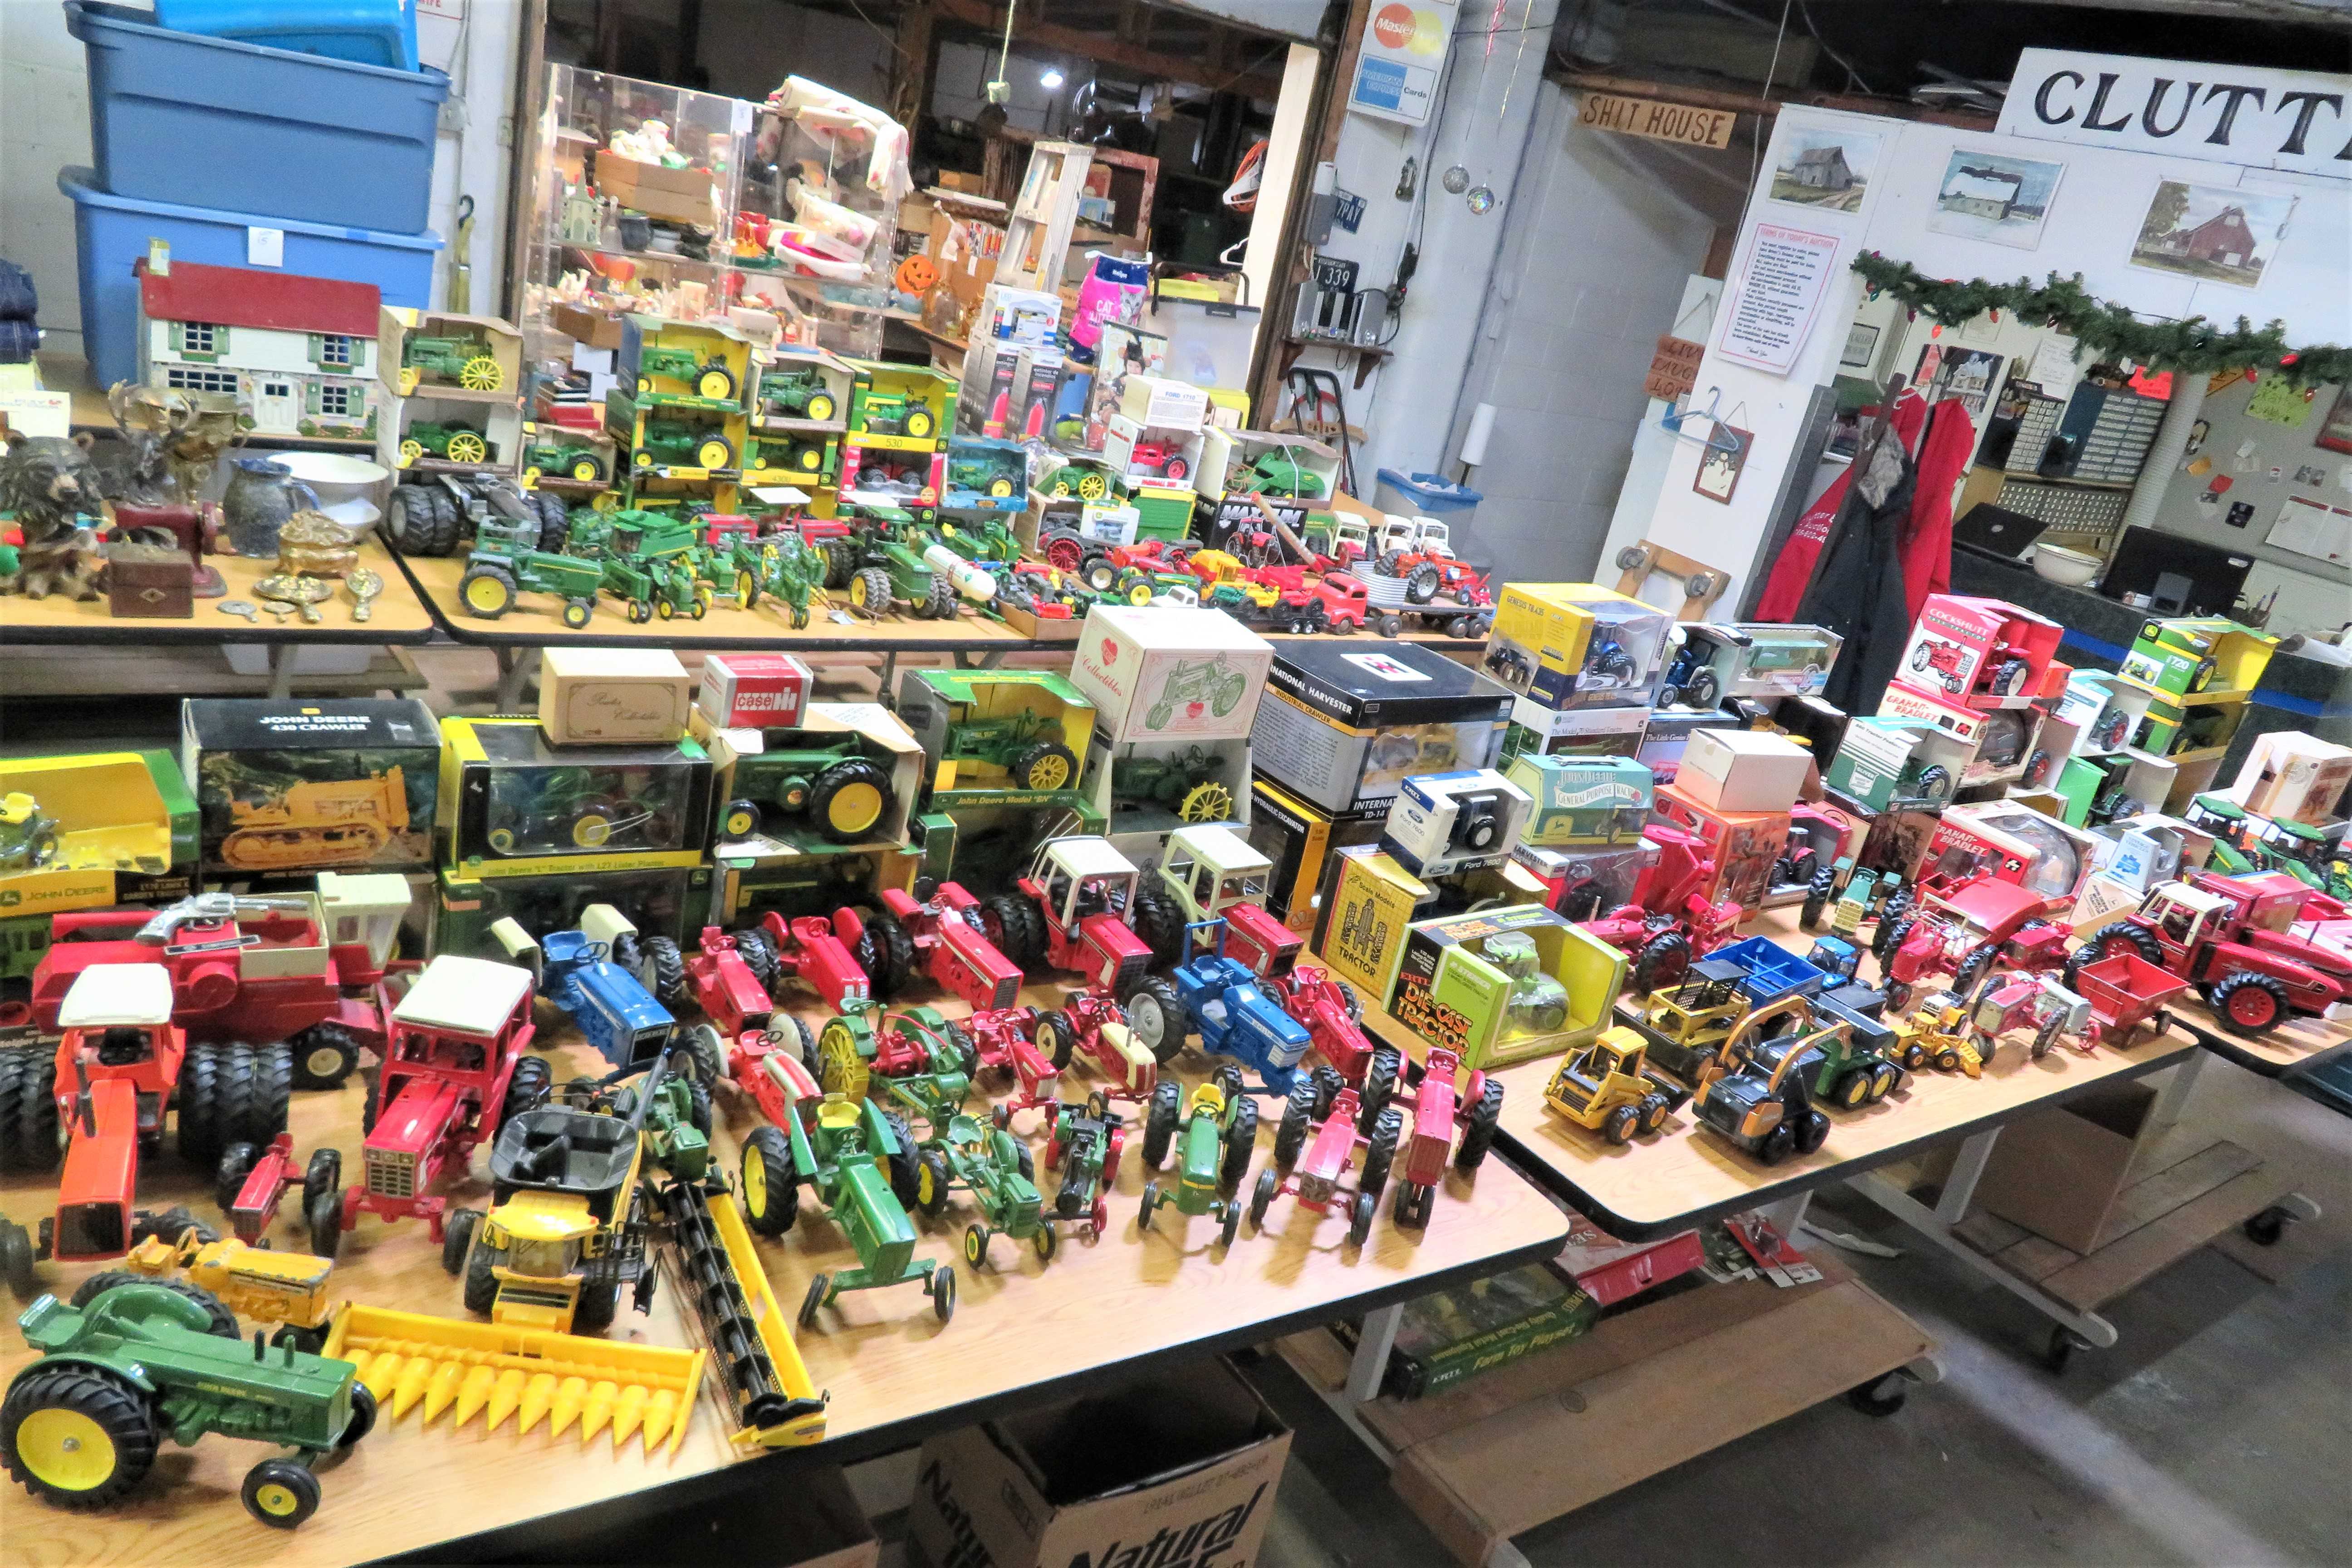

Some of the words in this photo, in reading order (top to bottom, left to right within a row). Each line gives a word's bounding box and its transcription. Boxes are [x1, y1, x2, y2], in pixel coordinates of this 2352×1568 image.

[1404, 87, 1427, 99] Cards
[1584, 96, 1639, 128] SHIT
[1647, 101, 1725, 145] HOUSE
[2034, 71, 2352, 161] CLUTT
[1096, 300, 1114, 314] CAT
[886, 439, 902, 448] 530
[1930, 608, 1989, 636] COCKSHUTT
[2171, 656, 2190, 671] 720
[1082, 654, 1122, 697] Collectibles
[1270, 663, 1306, 692] RNATIONAL
[1308, 686, 1353, 715] HARVESTER
[1276, 689, 1305, 710] INDUSTRIAL
[1305, 706, 1331, 724] CRAWLER
[1894, 705, 1939, 722] BRADLEY
[260, 715, 310, 724] JOHN
[1866, 728, 1883, 739] Tractor
[1558, 770, 1583, 787] JOHN
[1584, 770, 1616, 783] DEERE
[1353, 797, 1398, 810] INTERNAT
[1558, 791, 1585, 804] GENERAL
[1586, 784, 1612, 800] PURPOSE
[1612, 784, 1638, 799] TRACT
[1254, 794, 1279, 816] HYDRAULIC
[1278, 811, 1305, 833] EXCAVATOR
[1400, 814, 1411, 826] Ford
[1412, 823, 1425, 836] 7600
[1940, 835, 1988, 857] BRADLEY
[549, 864, 576, 872] Tractor
[1464, 861, 1481, 870] Ford
[25, 890, 63, 901] JOHN
[64, 886, 108, 897] DEERE
[1359, 882, 1373, 896] Scale
[1375, 891, 1395, 909] Models
[1339, 946, 1377, 977] TRACTOR
[1400, 971, 1431, 986] ERTL
[1405, 981, 1473, 1036] DIE-CAST
[1397, 996, 1470, 1061] TRACTOR
[1508, 1343, 1529, 1357] Toy
[1068, 1480, 1269, 1568] Natural
